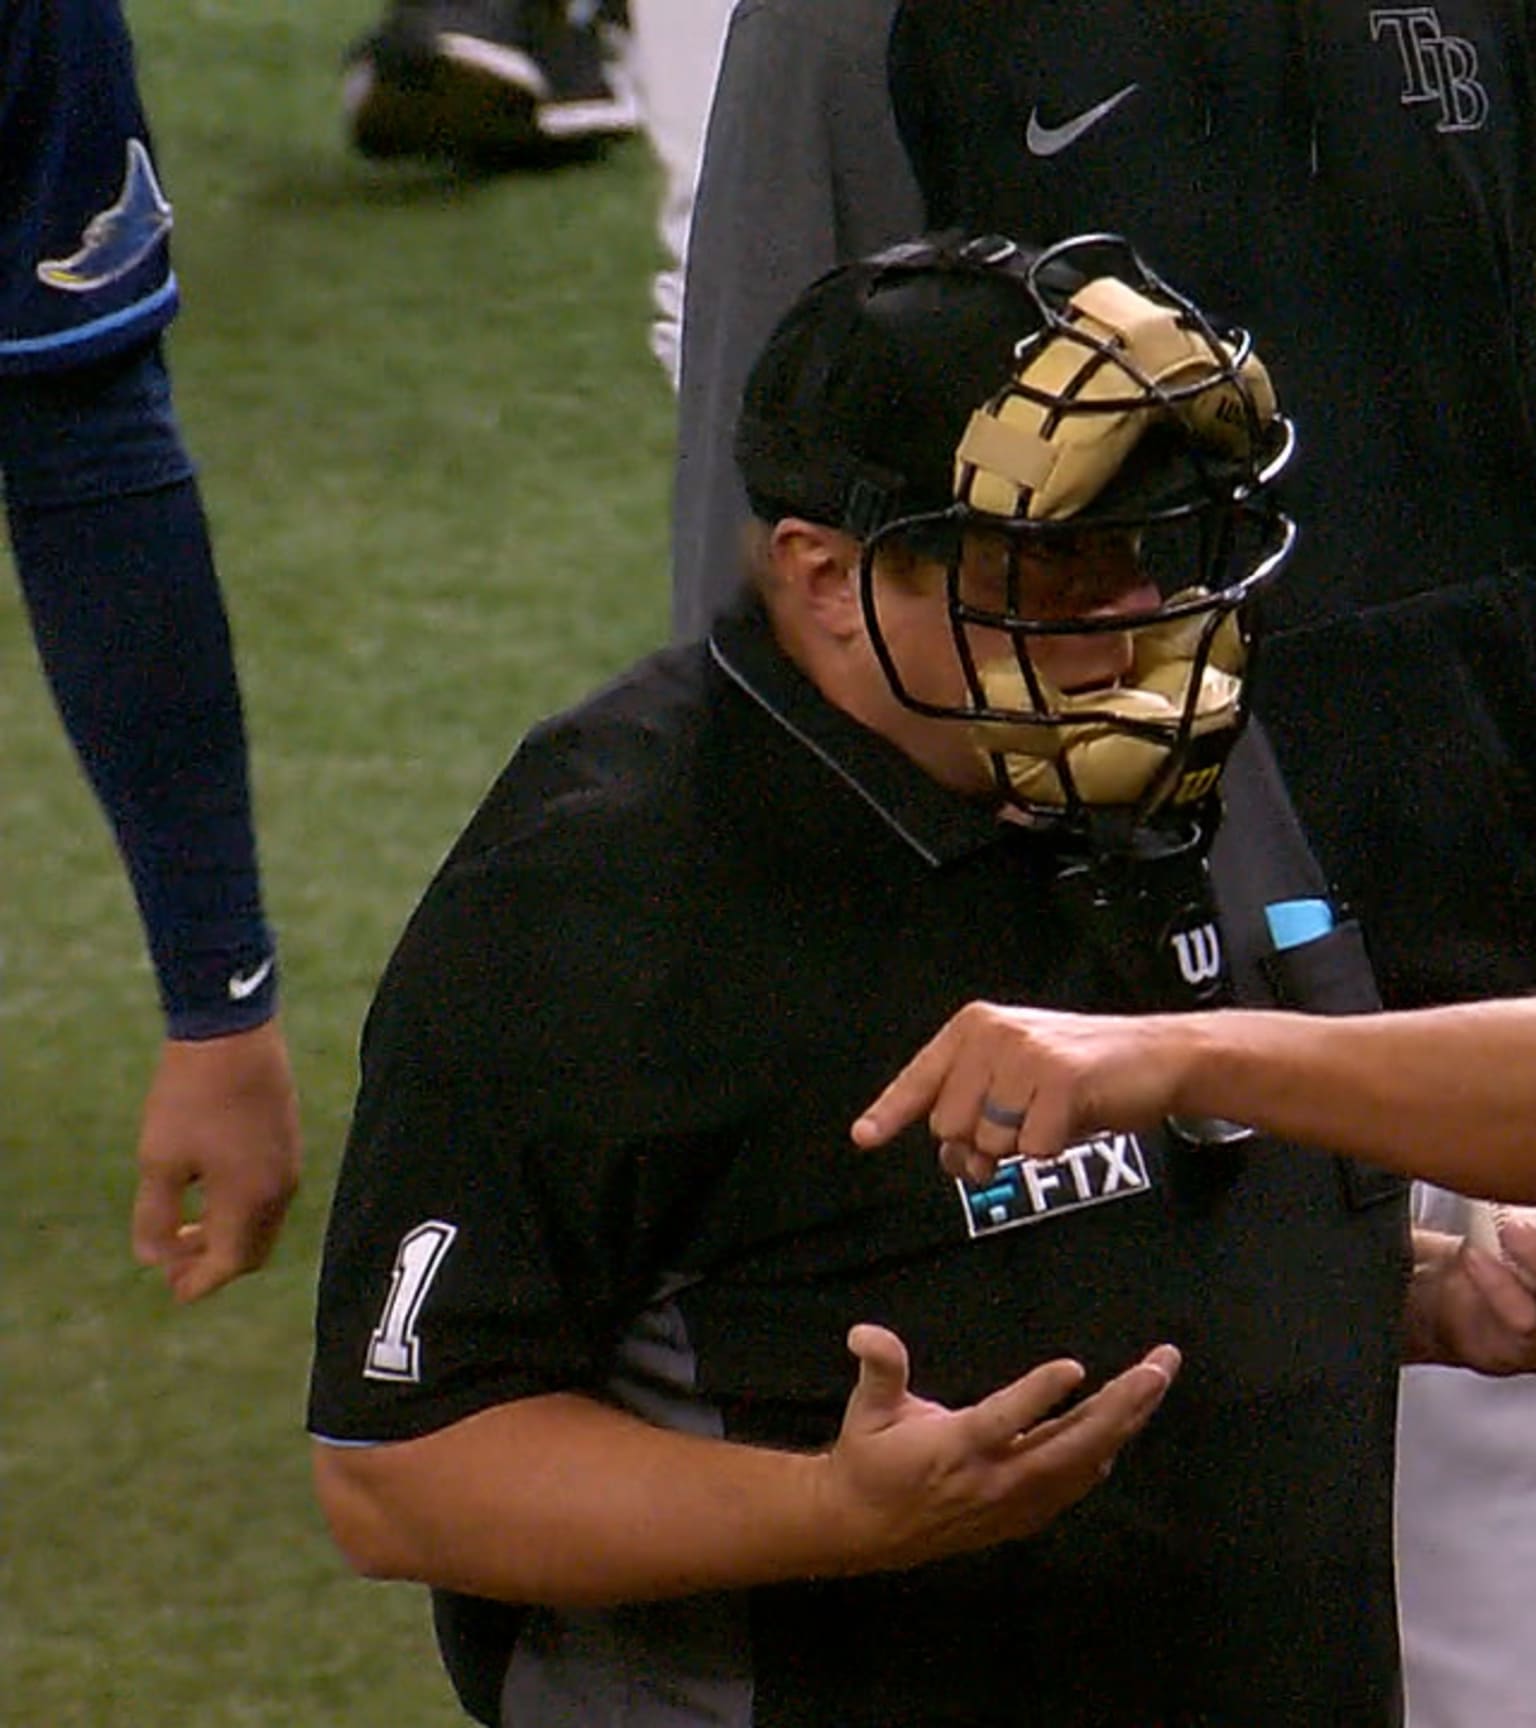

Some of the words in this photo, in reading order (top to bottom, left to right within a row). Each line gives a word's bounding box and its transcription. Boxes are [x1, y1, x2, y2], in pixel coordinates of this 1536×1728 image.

[1370, 7, 1489, 133] TB
[1021, 1134, 1143, 1213] FTX
[363, 1219, 458, 1382] 1
